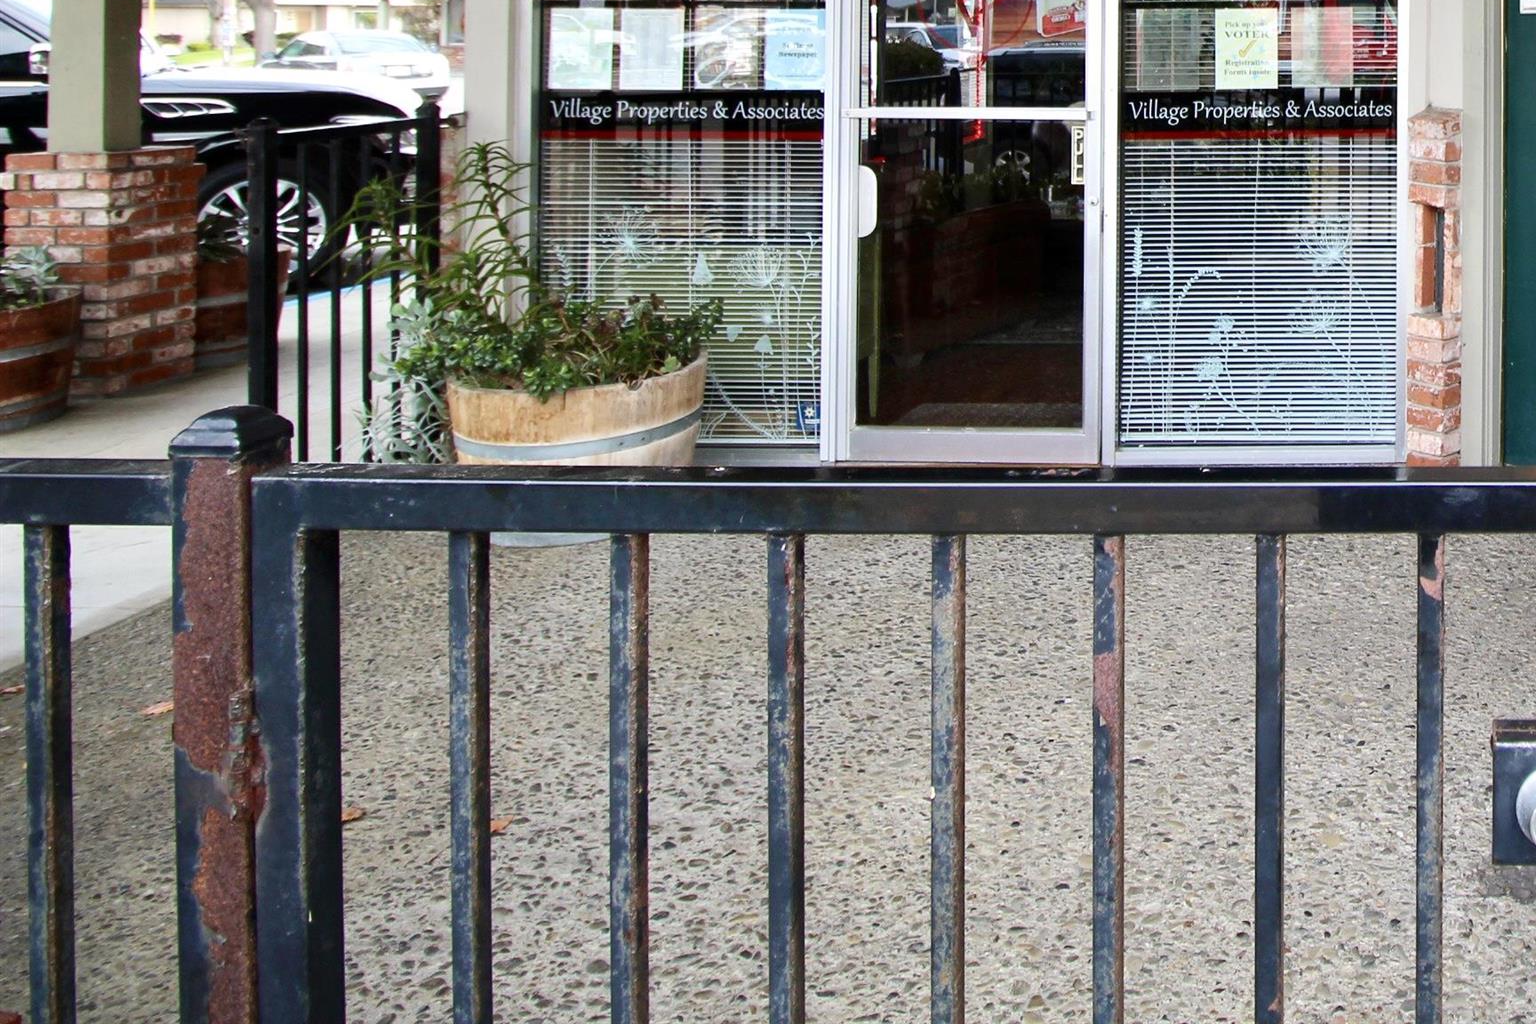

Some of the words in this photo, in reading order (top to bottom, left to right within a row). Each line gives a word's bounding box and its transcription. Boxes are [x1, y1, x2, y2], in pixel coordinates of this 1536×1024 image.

[1225, 29, 1270, 39] VOTER
[550, 97, 612, 125] Village
[616, 99, 708, 125] Properties
[713, 100, 729, 119] &
[732, 100, 825, 120] Associates
[1128, 99, 1189, 125] Village
[1193, 100, 1280, 125] Properties
[1285, 99, 1300, 119] &
[1304, 99, 1393, 119] Associates
